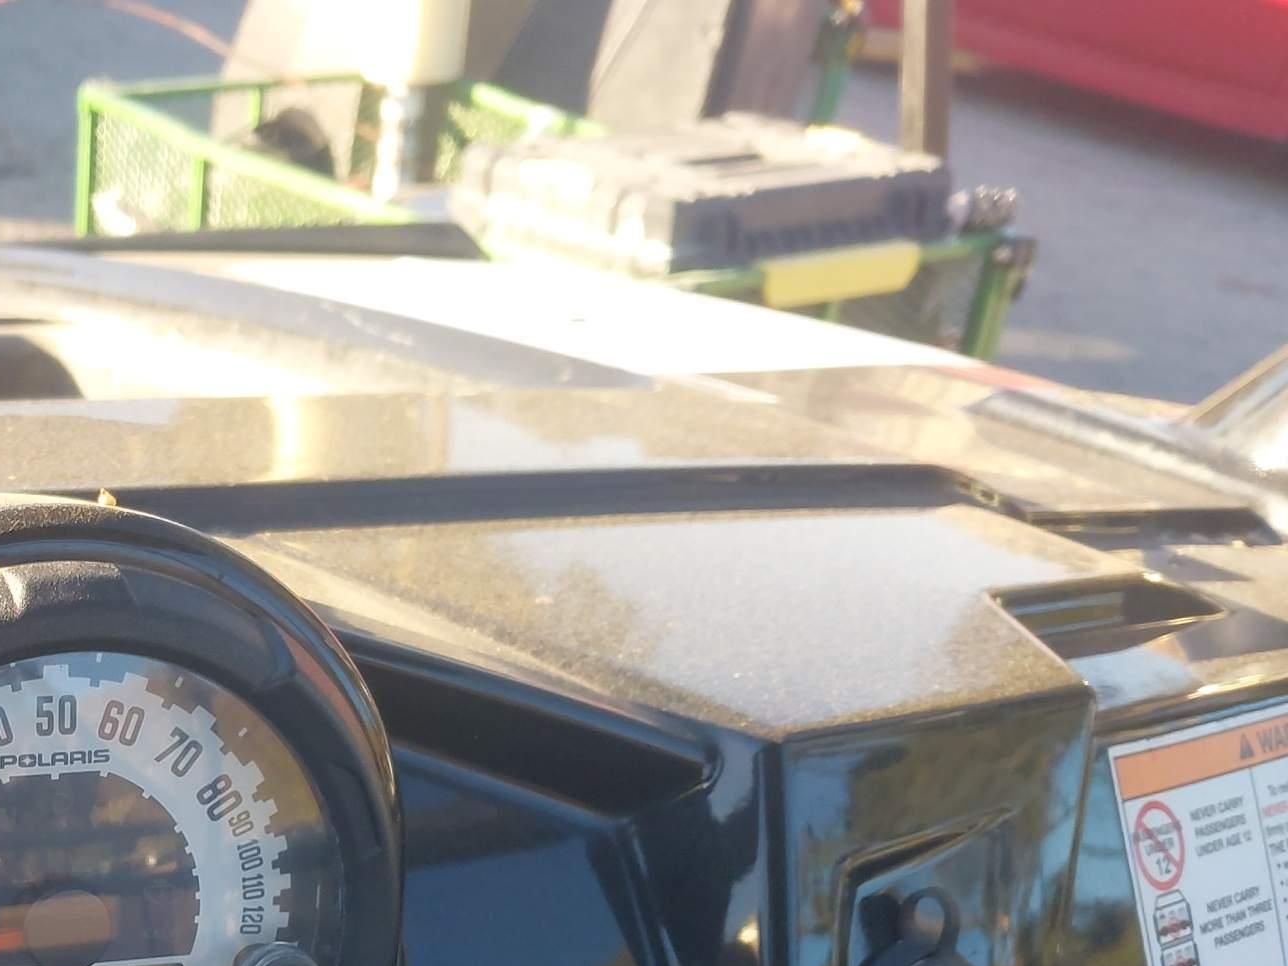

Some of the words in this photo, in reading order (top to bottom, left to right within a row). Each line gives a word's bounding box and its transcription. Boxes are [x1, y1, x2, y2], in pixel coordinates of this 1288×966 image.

[36, 695, 77, 736] 50
[98, 700, 145, 746] 60
[0, 749, 110, 769] POLARIS
[154, 726, 203, 778] 70
[196, 774, 243, 822] 80
[228, 810, 254, 837] 90
[237, 839, 264, 872] 100
[241, 873, 264, 901] 110
[240, 905, 264, 935] 120
